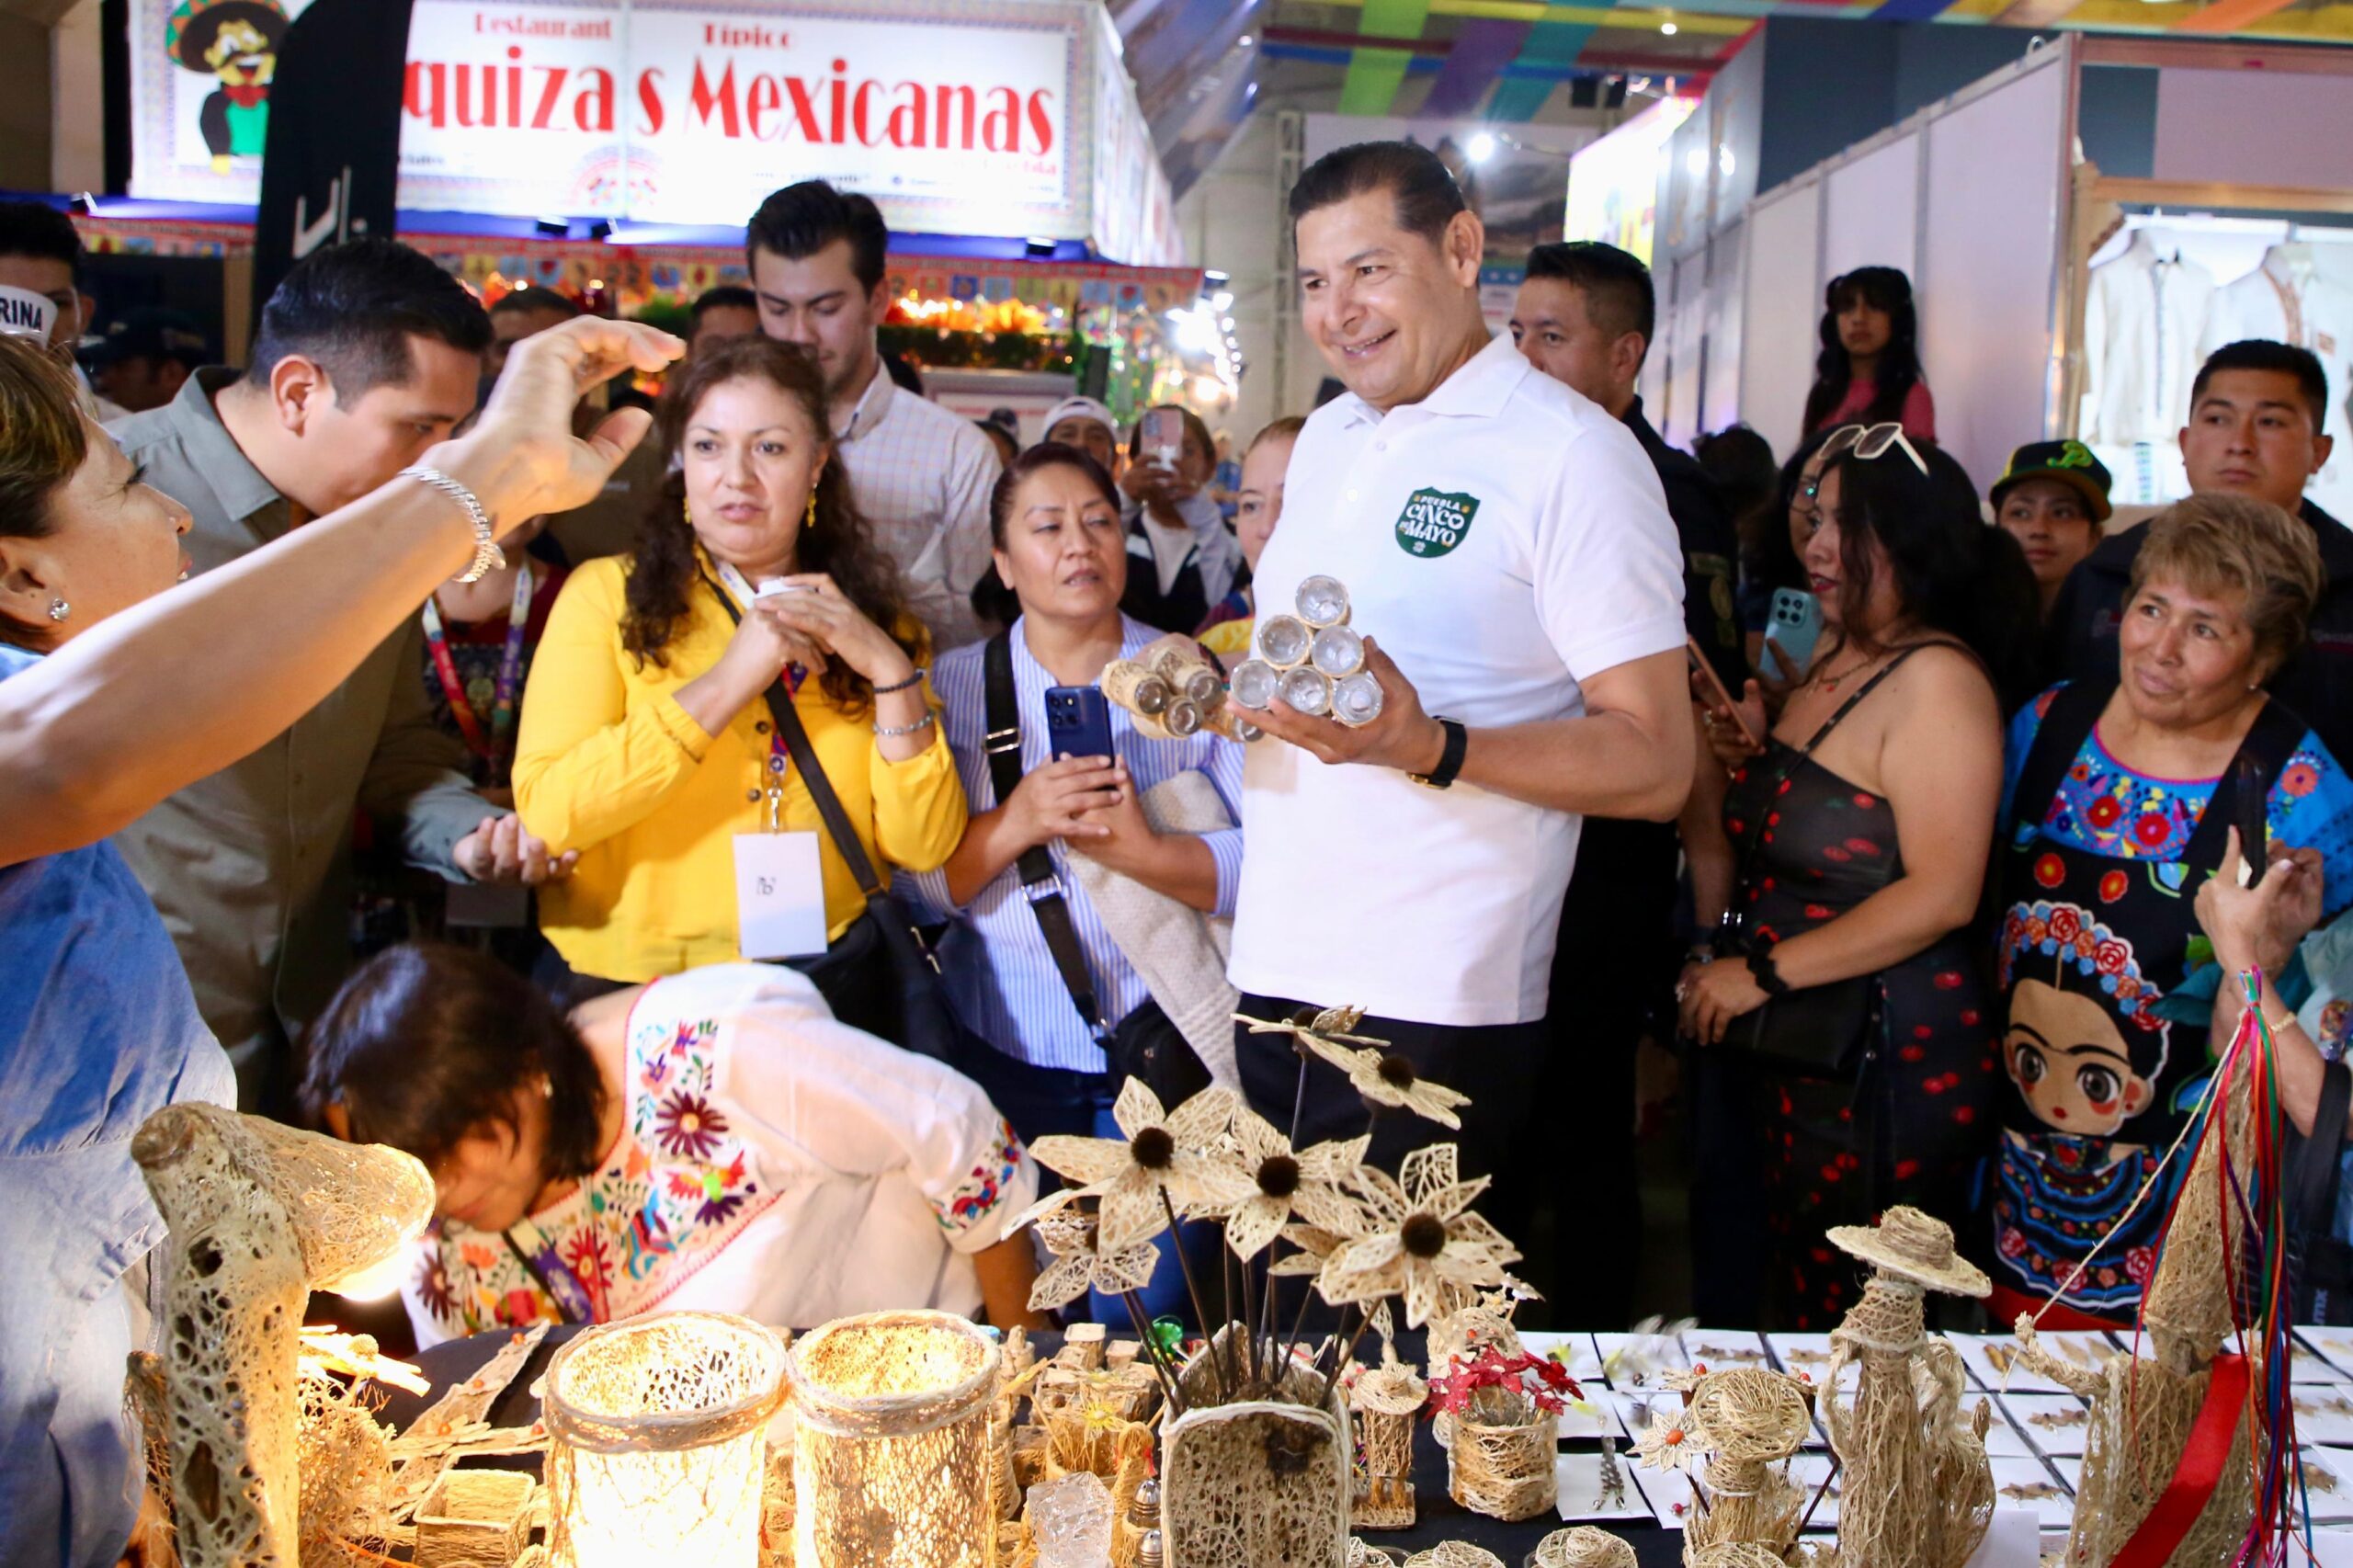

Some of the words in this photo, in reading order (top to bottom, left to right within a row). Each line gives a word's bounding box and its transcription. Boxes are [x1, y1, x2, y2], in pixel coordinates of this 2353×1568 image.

[687, 56, 1054, 155] Mexicanas
[1406, 503, 1465, 530] CINCO
[1404, 520, 1456, 546] MAYO
